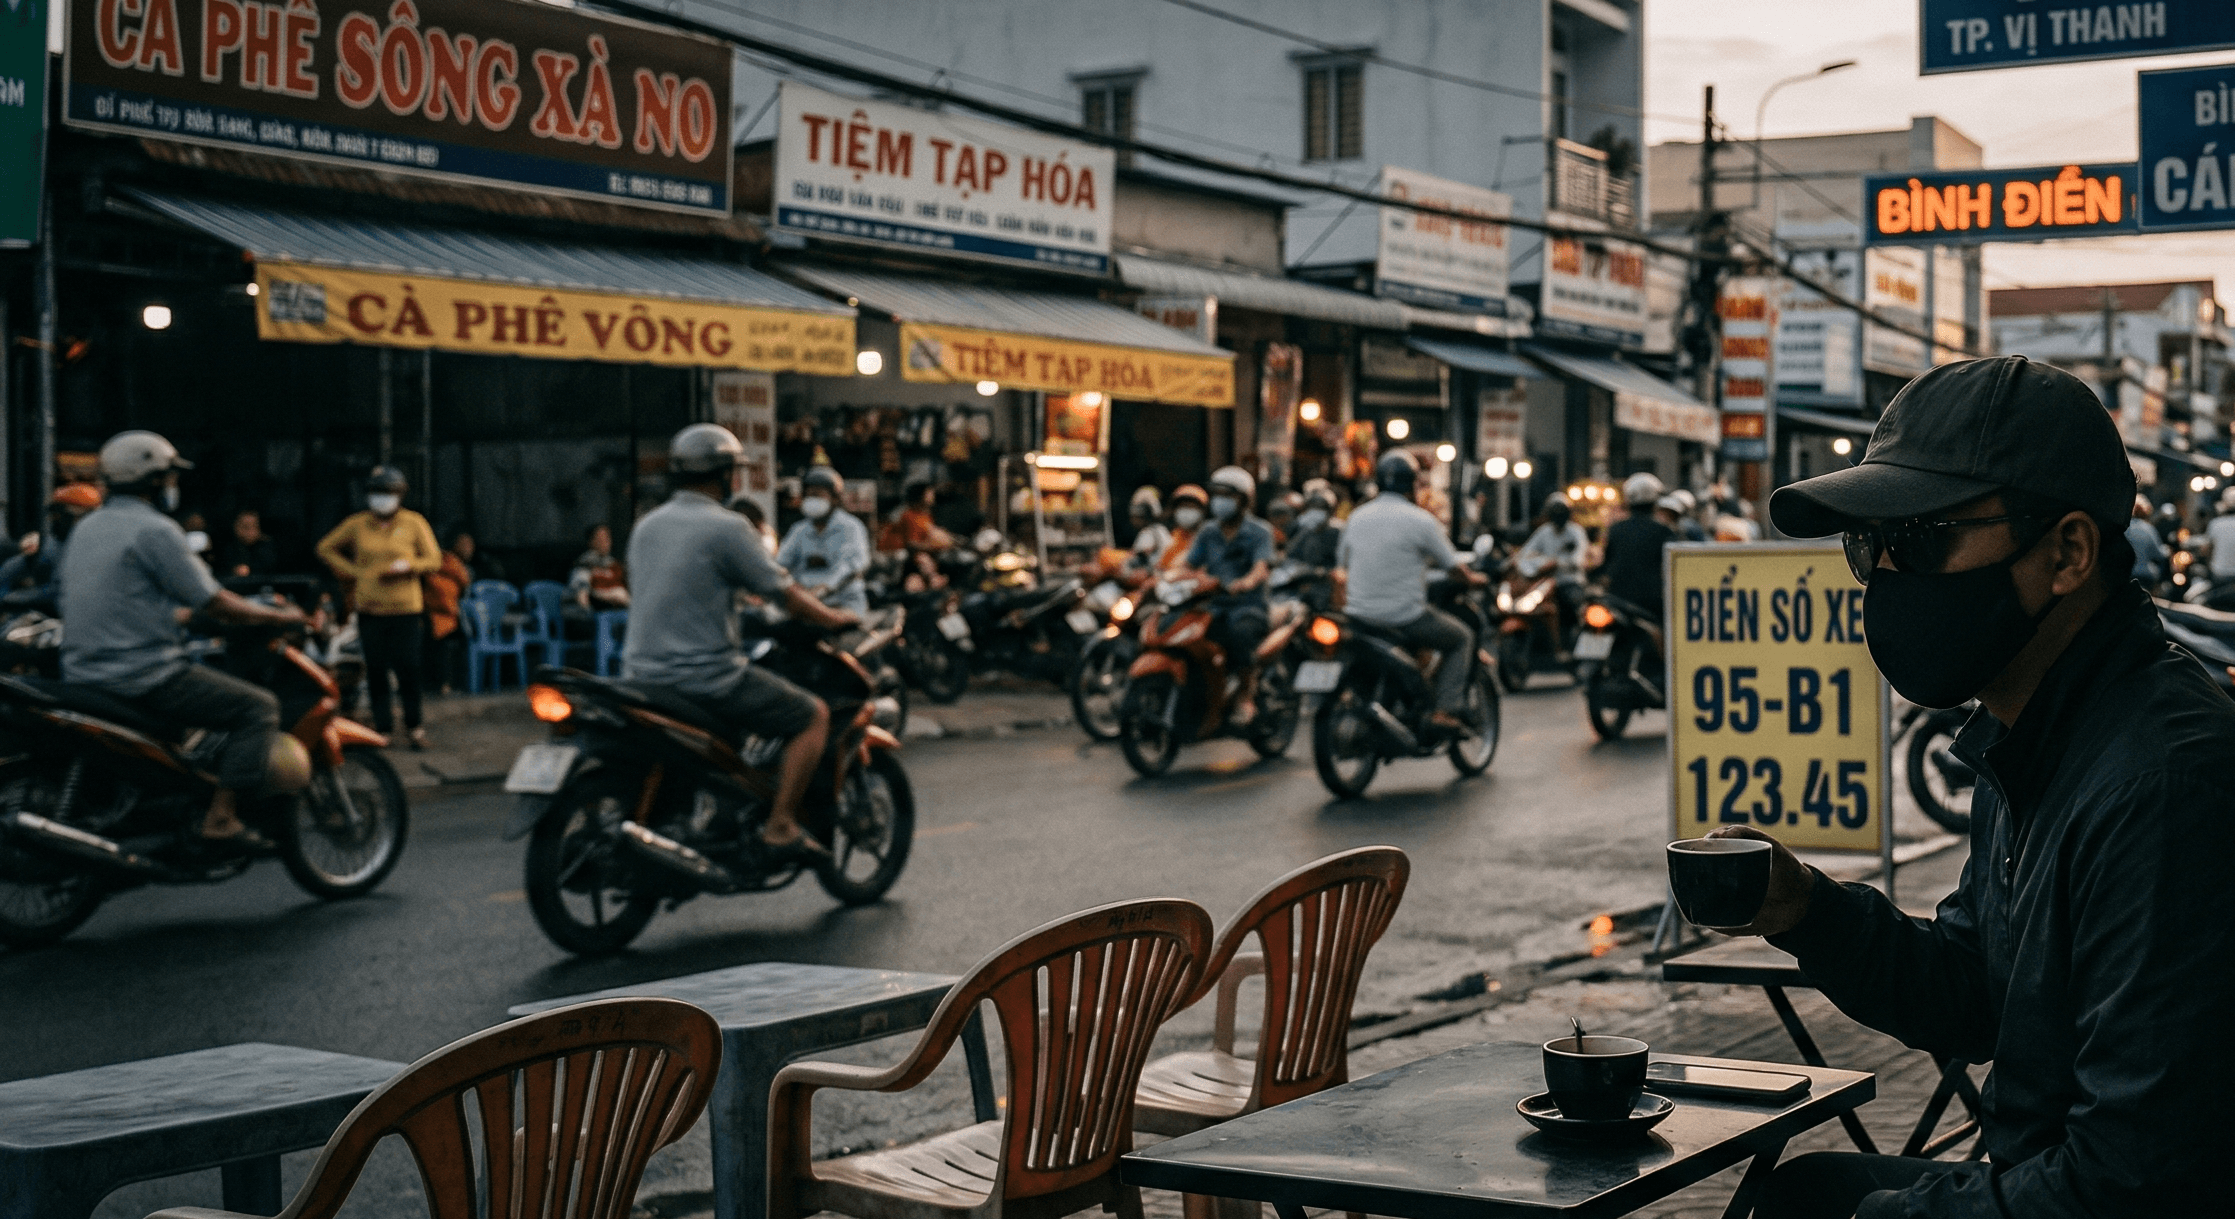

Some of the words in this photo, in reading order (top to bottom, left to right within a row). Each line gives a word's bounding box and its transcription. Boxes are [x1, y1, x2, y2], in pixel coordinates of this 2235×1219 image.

[1947, 18, 1993, 55] TP.
[2004, 12, 2038, 56] VỊ
[2048, 2, 2166, 46] THANH
[335, 0, 521, 131] SÔNG
[530, 34, 622, 149] XÀ
[633, 68, 717, 162] NO
[2195, 81, 2235, 126] BÌ
[802, 108, 914, 182] TIỆM
[929, 138, 1008, 199] TẠP
[1022, 151, 1096, 210] HÓA
[1878, 178, 1992, 234] BÌNH
[348, 283, 434, 336] CÀ
[453, 296, 567, 347] PHÊ
[582, 304, 733, 358] VÔNG
[1685, 564, 1759, 642] BIỂN
[1770, 566, 1813, 644] SỐ
[1824, 589, 1865, 644] XE
[1692, 665, 1852, 736] 95-B1
[1687, 756, 1869, 830] 123.45
